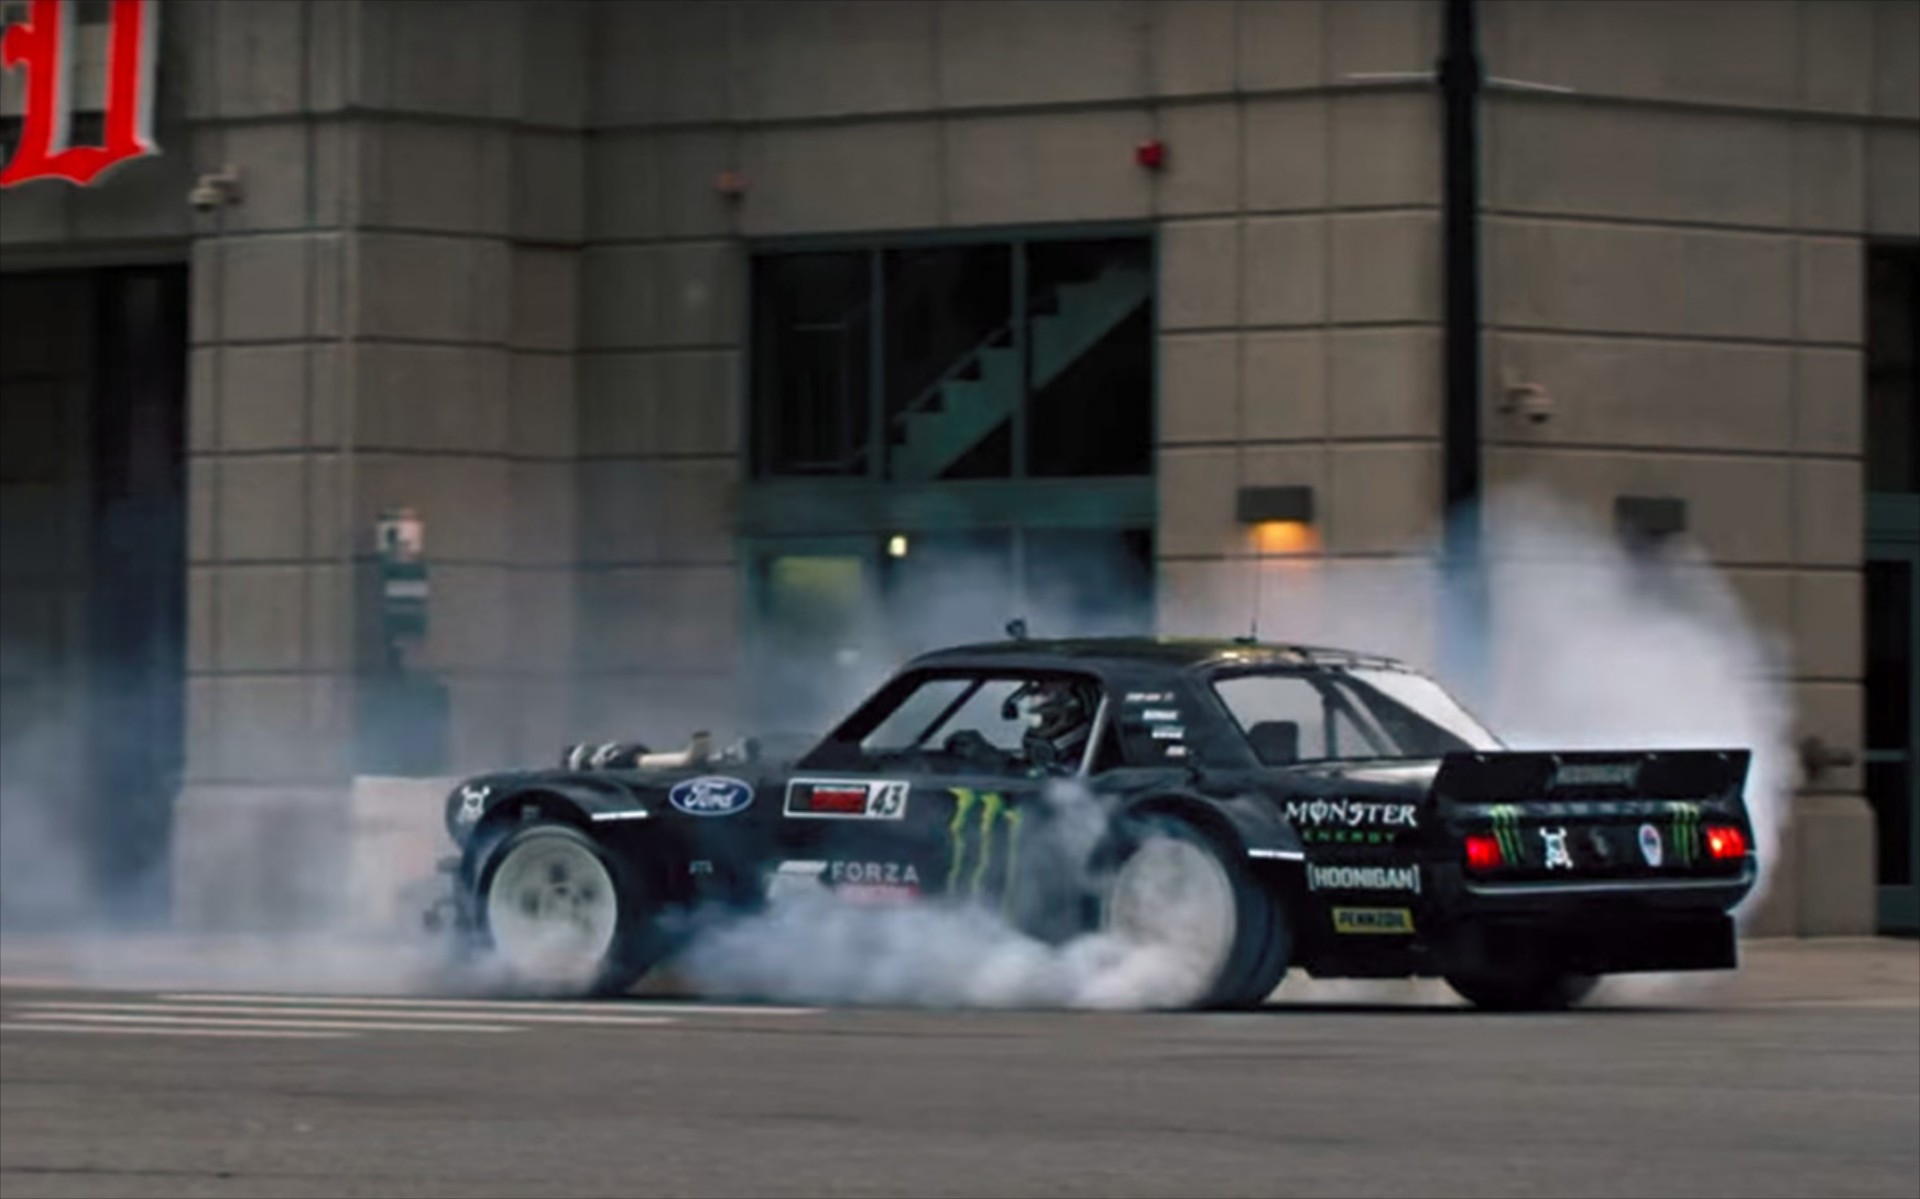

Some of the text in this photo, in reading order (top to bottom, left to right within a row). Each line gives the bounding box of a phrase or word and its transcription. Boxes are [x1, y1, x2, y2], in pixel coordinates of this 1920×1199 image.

[683, 782, 739, 808] Ford
[870, 784, 903, 816] 43
[1284, 798, 1417, 827] MONSTER
[1302, 829, 1396, 844] ENERGY
[832, 860, 919, 883] FORZA
